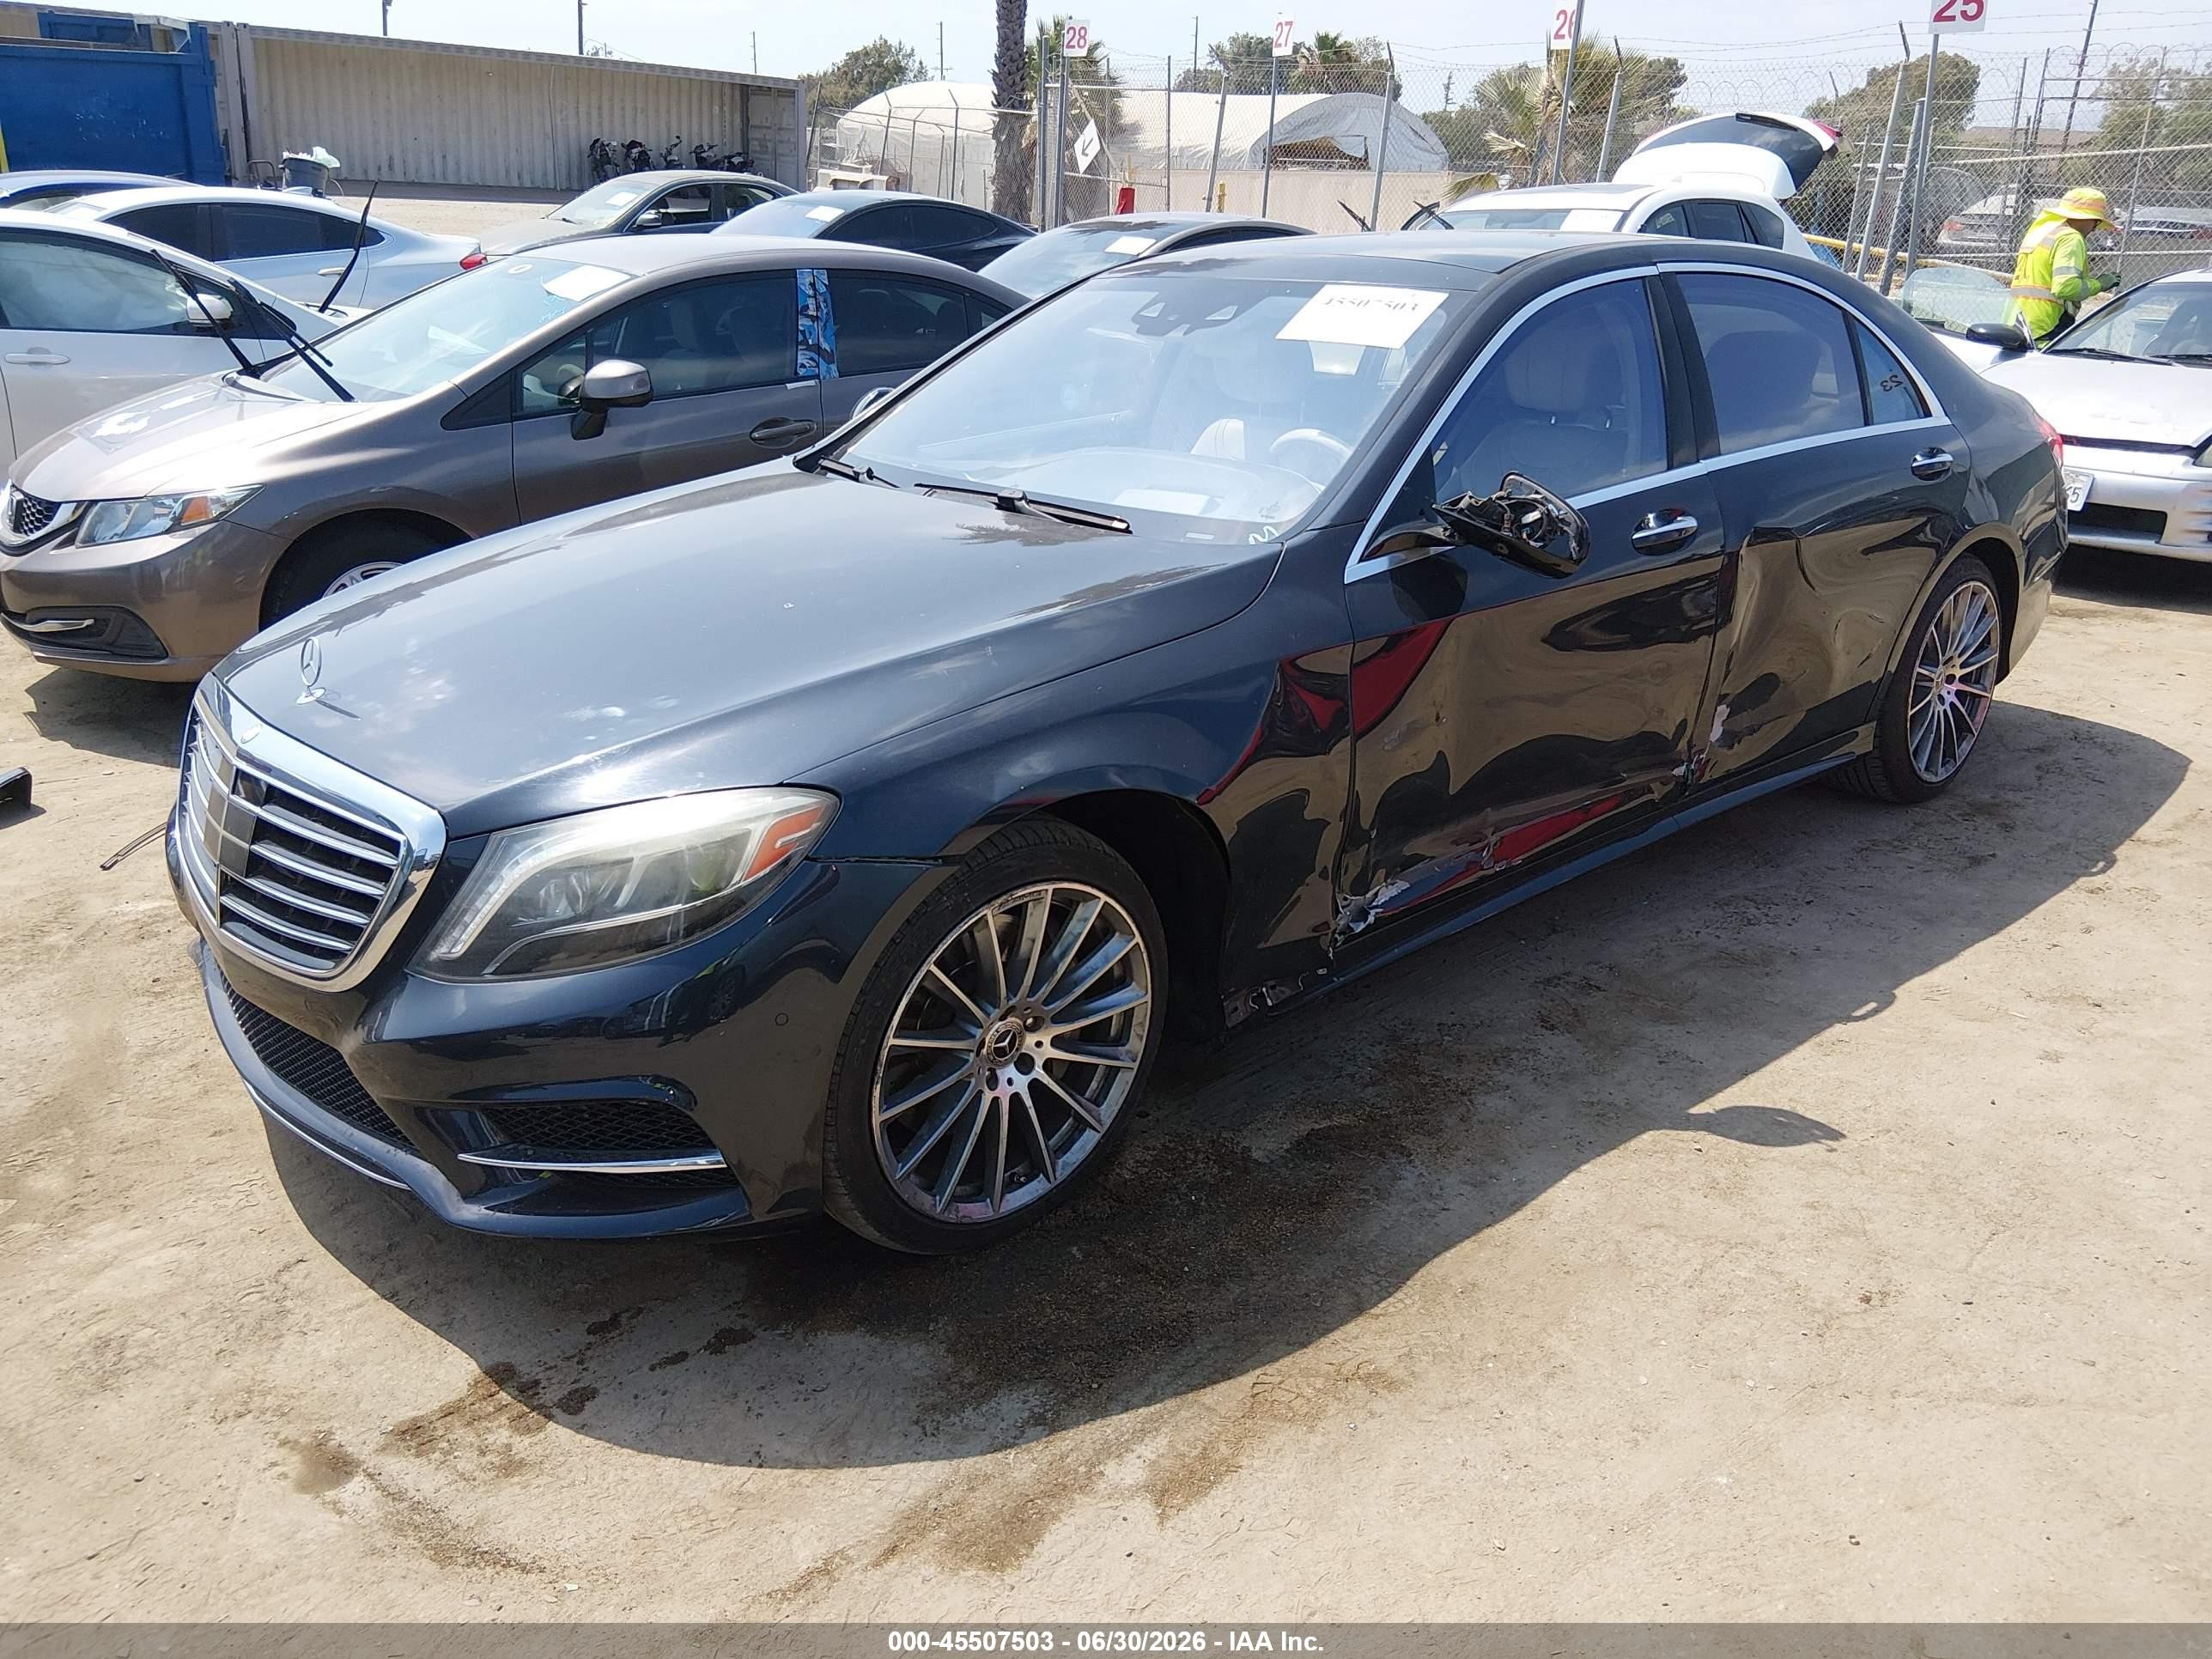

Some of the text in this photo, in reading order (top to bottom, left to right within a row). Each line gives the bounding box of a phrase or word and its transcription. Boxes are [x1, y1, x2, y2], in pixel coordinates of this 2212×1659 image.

[1933, 0, 1984, 22] 25
[1066, 26, 1088, 49] 28
[1273, 21, 1294, 48] 27
